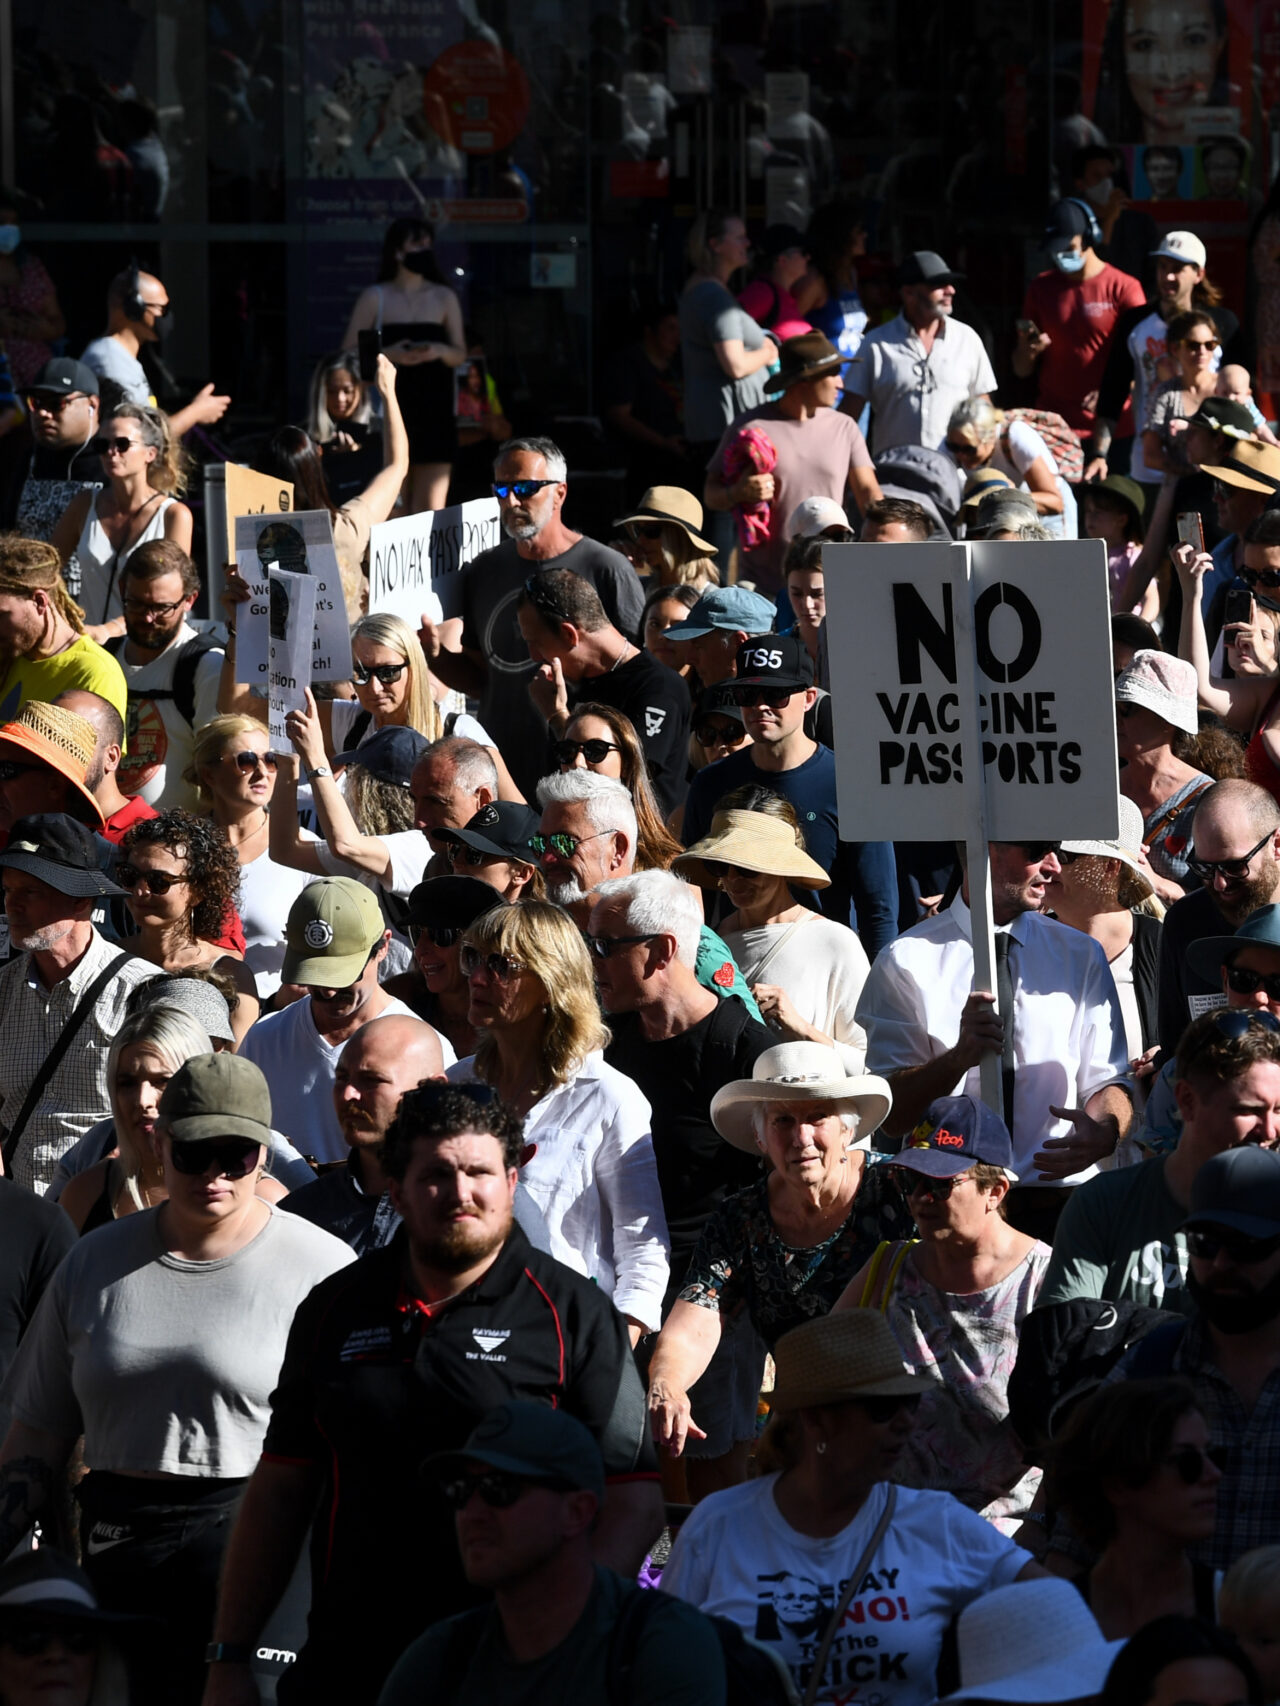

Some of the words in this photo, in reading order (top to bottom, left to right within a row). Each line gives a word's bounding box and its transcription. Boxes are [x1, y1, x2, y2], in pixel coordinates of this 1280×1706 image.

[400, 537, 425, 590] VAX
[430, 516, 498, 579] PASSPORT
[892, 582, 1042, 684] NO
[743, 648, 784, 669] TS5
[934, 1127, 965, 1149] Pooh
[93, 1520, 123, 1541] NIKE
[837, 1595, 911, 1629] NO!
